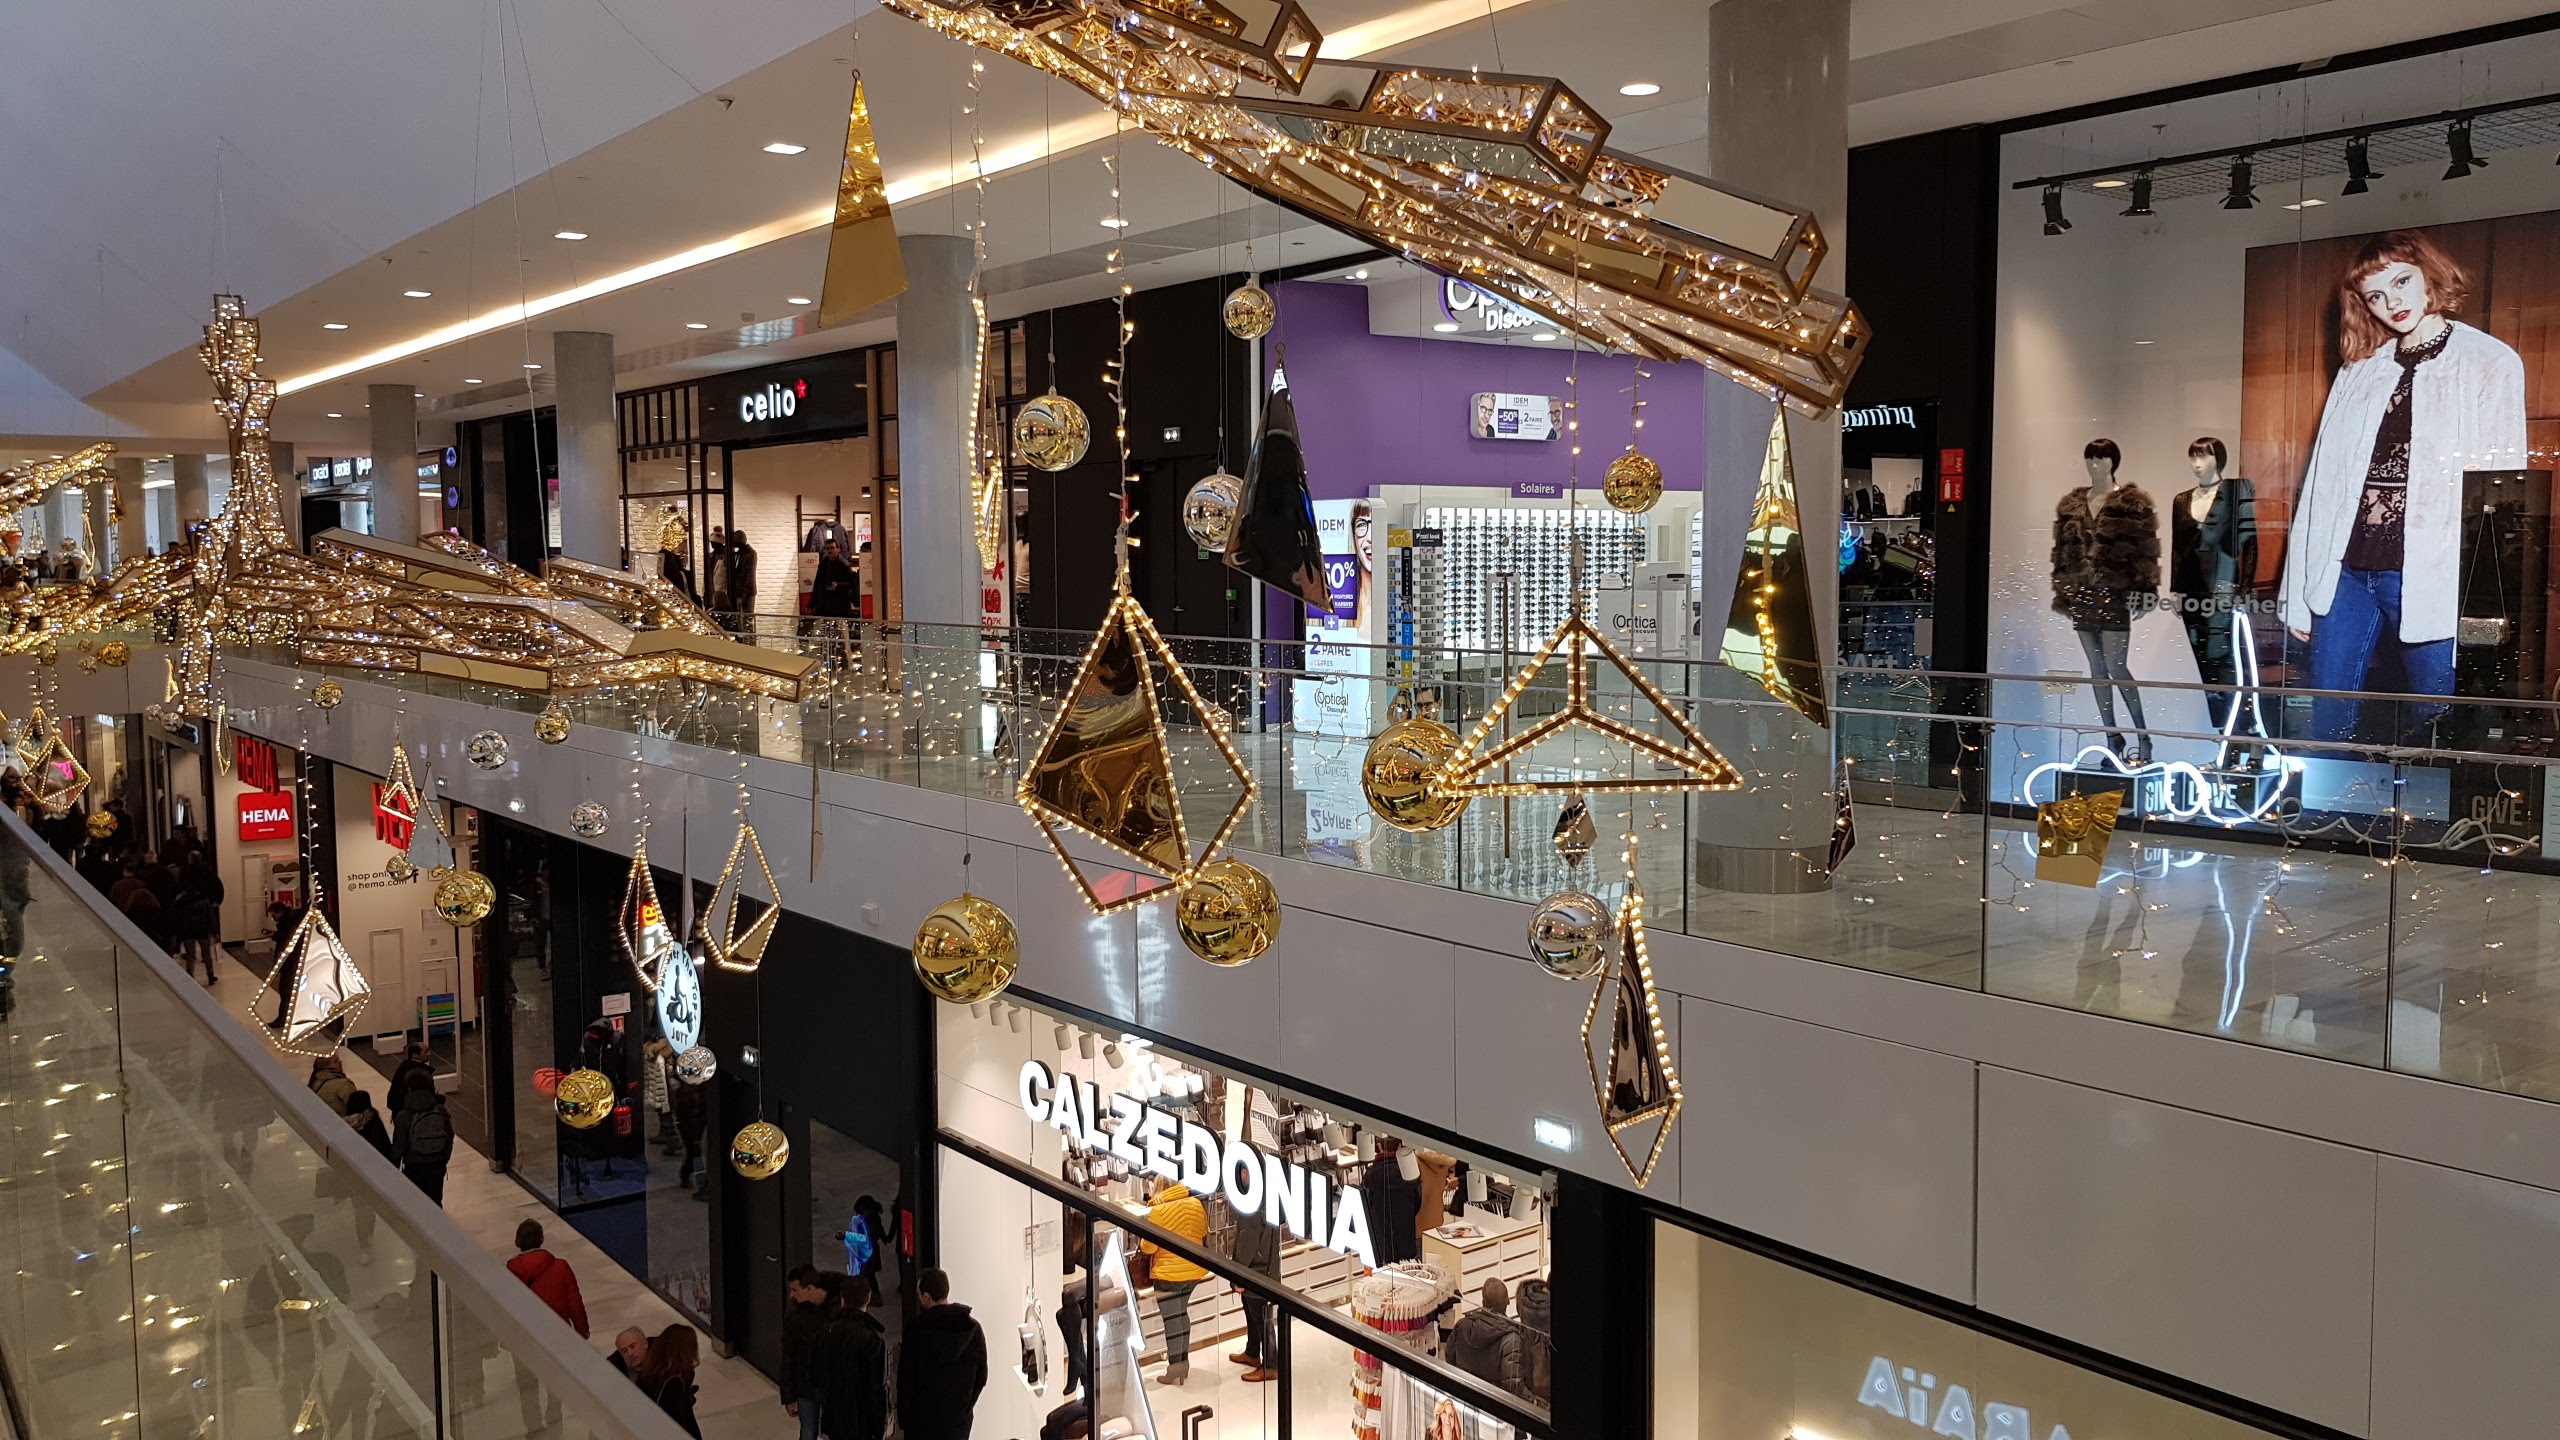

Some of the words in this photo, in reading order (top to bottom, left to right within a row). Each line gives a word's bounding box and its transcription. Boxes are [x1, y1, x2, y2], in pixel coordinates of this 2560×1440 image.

[741, 383, 796, 423] celio
[1520, 482, 1555, 494] Solaires
[1318, 518, 1345, 531] IDEM
[1317, 690, 1349, 707] Optical
[236, 735, 281, 796] HEMA
[242, 808, 290, 824] HEMA
[2471, 794, 2524, 826] GIVE
[347, 873, 371, 881] shop
[358, 879, 407, 889] hema.com
[1018, 1059, 1382, 1269] CALZEDONIA
